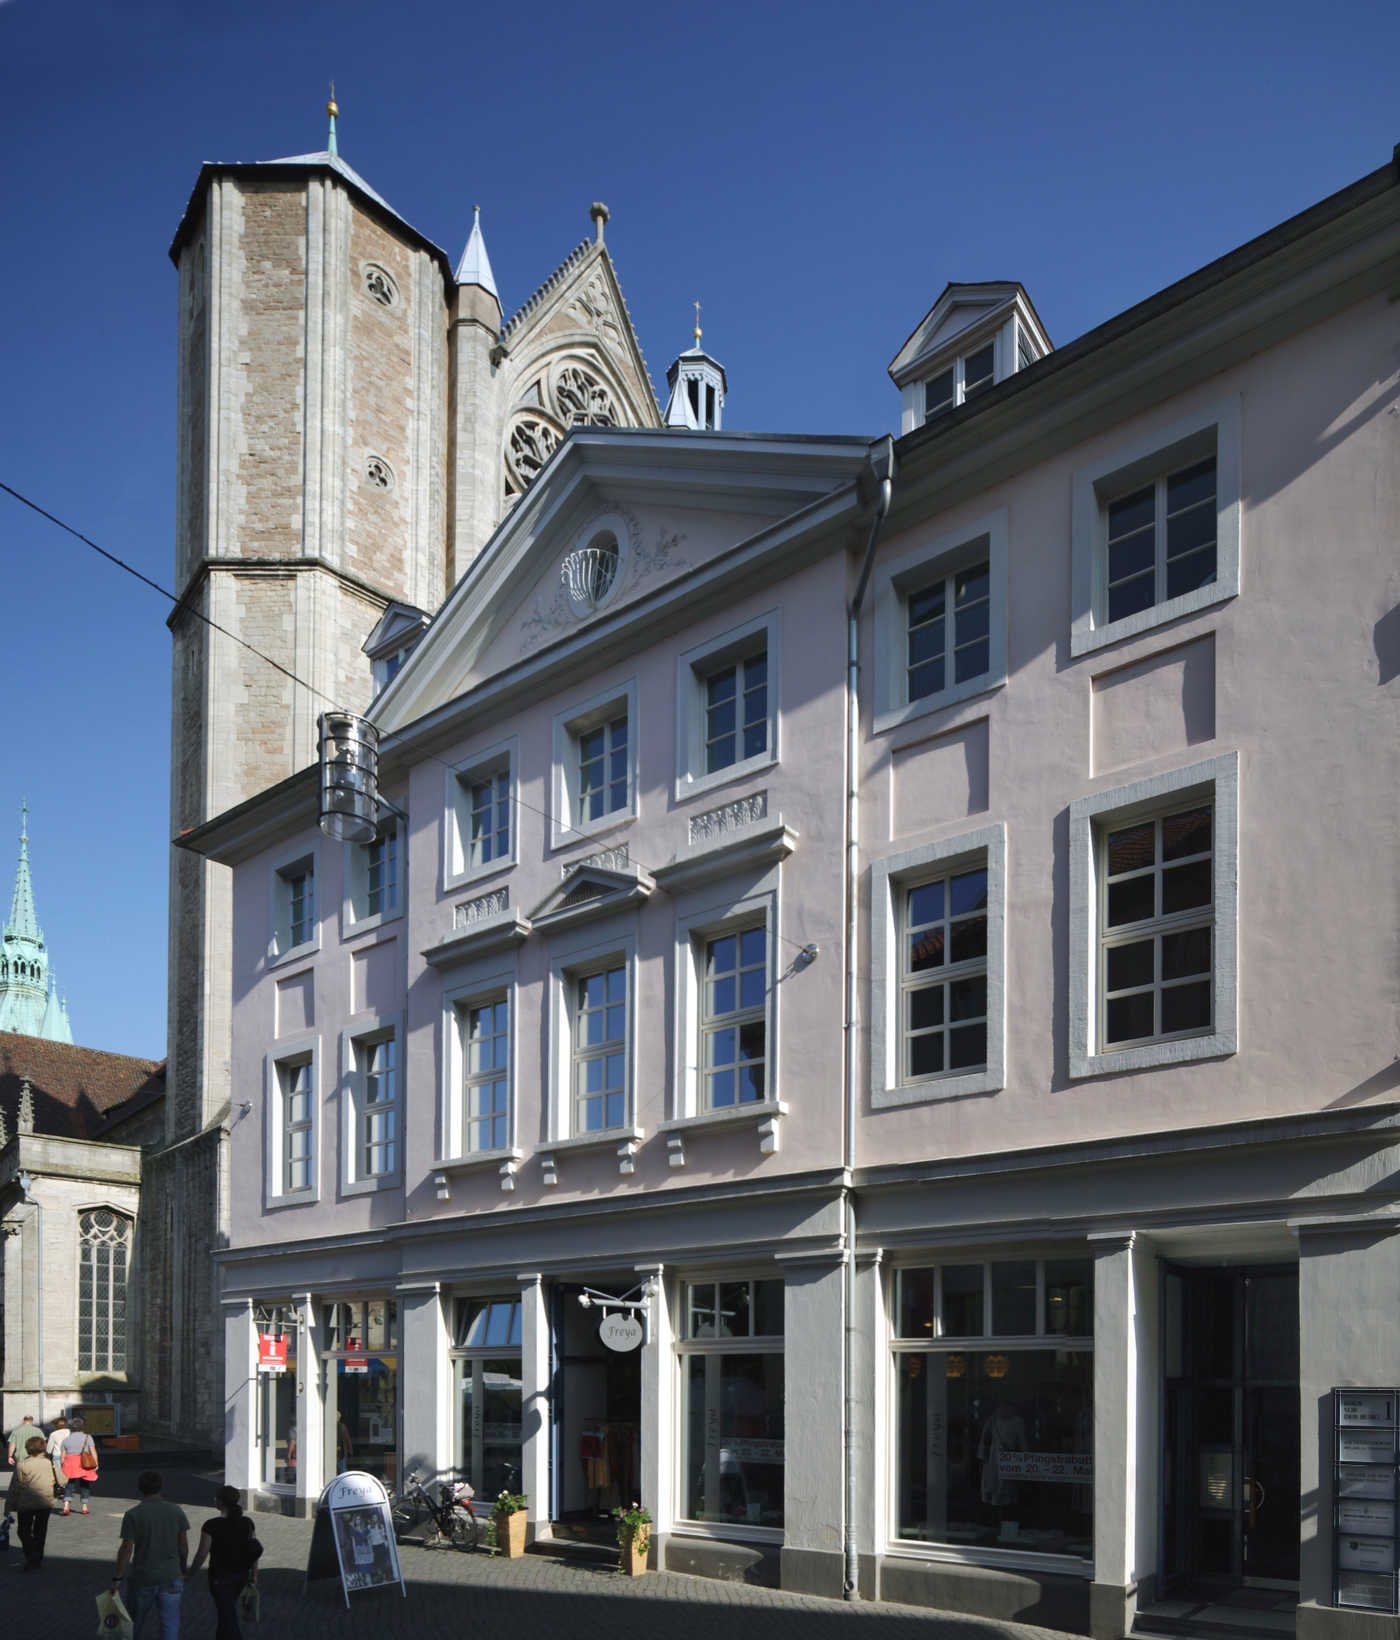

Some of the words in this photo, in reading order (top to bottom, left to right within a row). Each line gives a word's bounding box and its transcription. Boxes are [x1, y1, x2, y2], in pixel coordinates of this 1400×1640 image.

[607, 1326, 636, 1340] Freya
[1024, 1453, 1093, 1465] Pfingstrabatt
[1026, 1464, 1041, 1473] 20.
[1052, 1465, 1068, 1474] 22.
[1073, 1466, 1093, 1475] Mai
[338, 1486, 373, 1499] Freya
